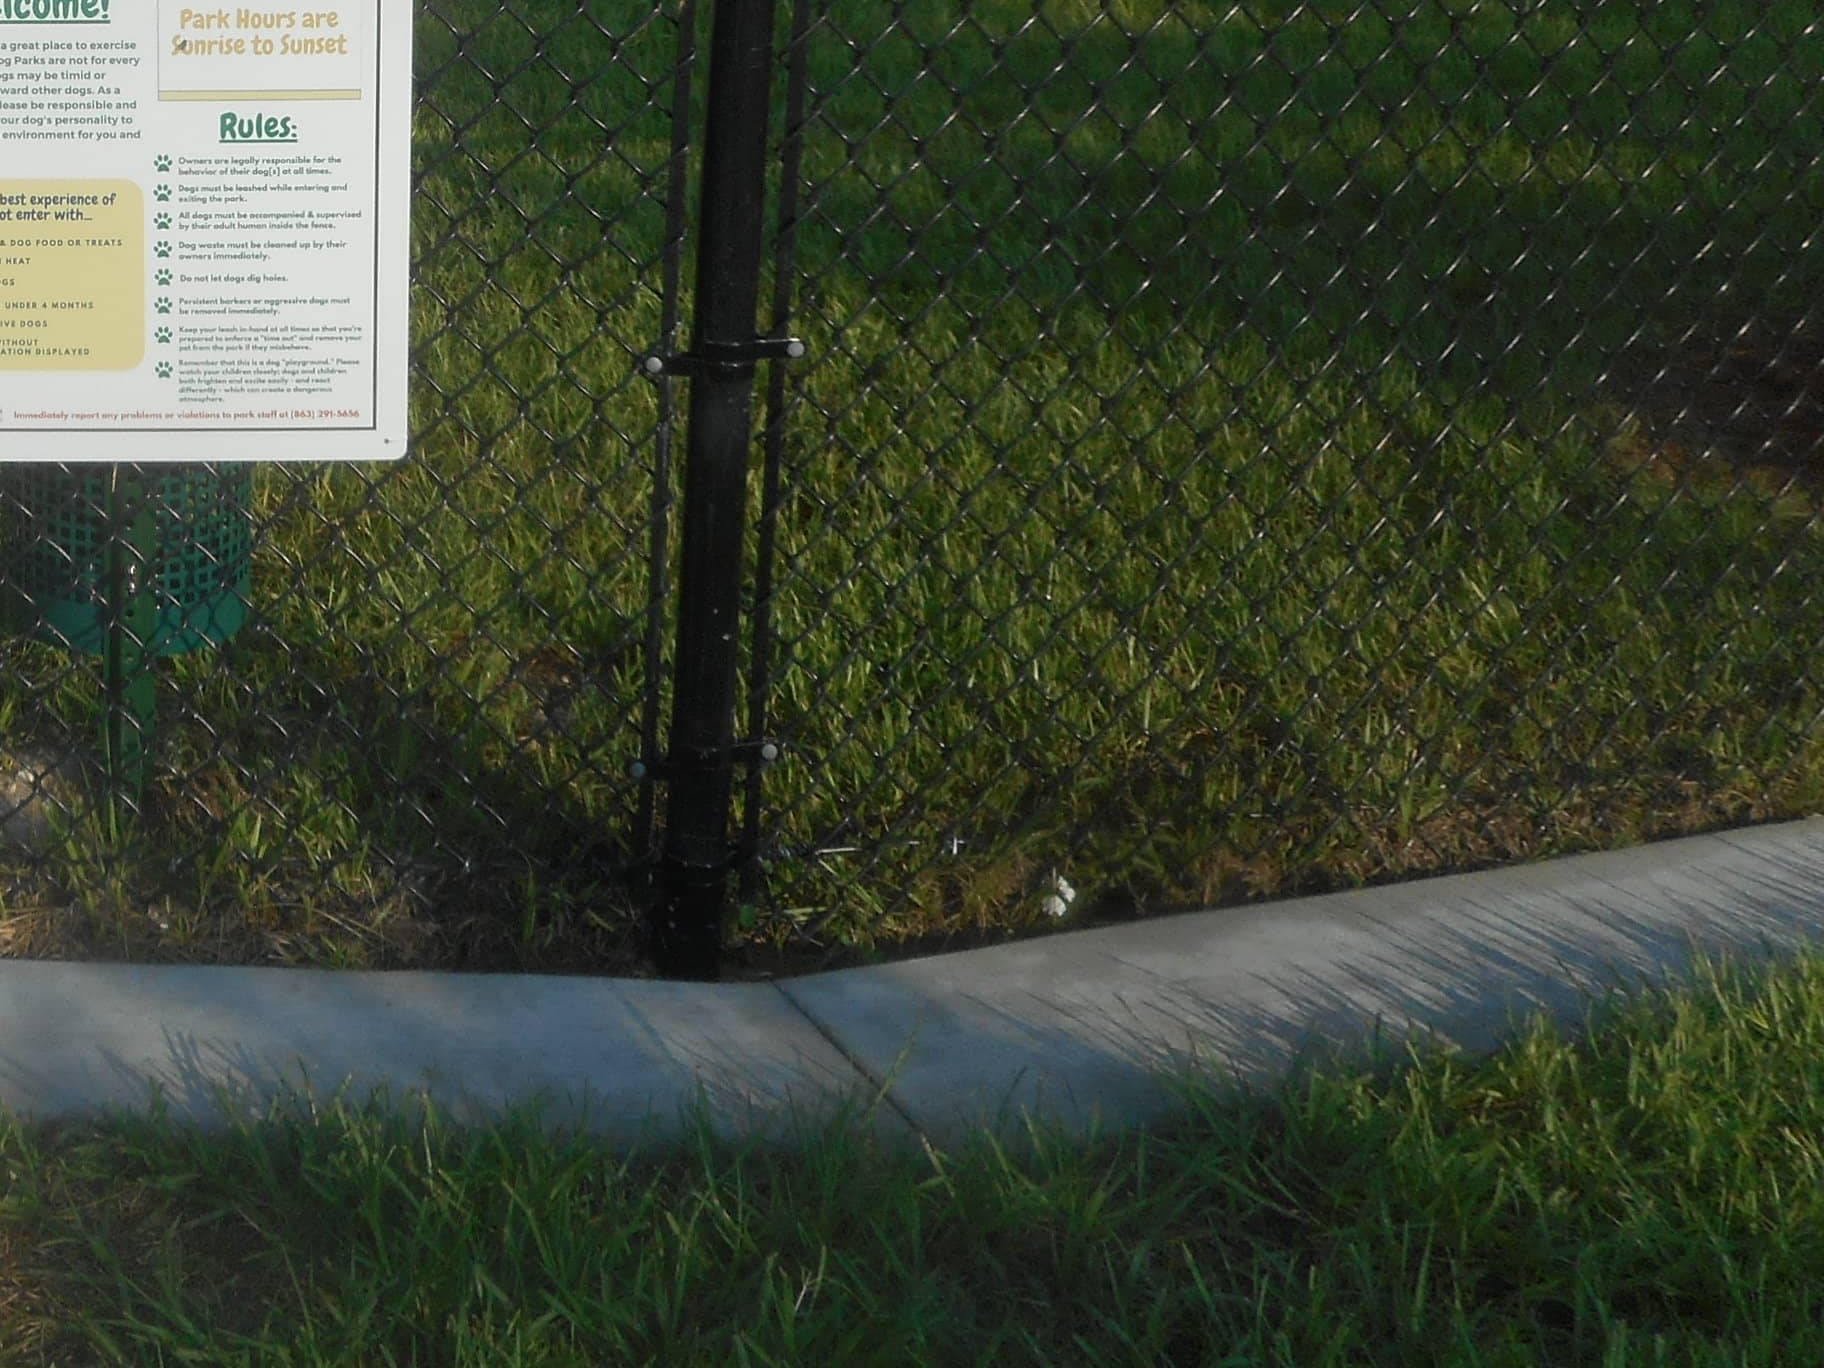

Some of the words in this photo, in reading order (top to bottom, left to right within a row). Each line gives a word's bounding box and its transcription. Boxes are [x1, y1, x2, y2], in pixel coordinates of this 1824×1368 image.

[180, 8, 229, 29] Park
[236, 8, 296, 29] Hours
[302, 11, 338, 28] are
[9, 42, 39, 52] great
[42, 40, 72, 51] place
[75, 41, 87, 49] to
[89, 39, 136, 49] exercise
[171, 34, 245, 55] Sunrise
[250, 34, 273, 55] to
[279, 33, 347, 55] Sunset
[14, 55, 45, 64] Parks
[69, 56, 87, 64] not
[90, 55, 106, 64] for
[109, 57, 140, 66] every
[17, 72, 41, 81] may
[44, 71, 57, 79] be
[60, 70, 90, 80] timid
[31, 85, 62, 94] other
[64, 85, 94, 96] dogs.
[97, 85, 111, 94] As
[30, 100, 44, 109] be
[47, 99, 112, 111] responsible
[115, 100, 136, 109] and
[22, 115, 52, 126] dog's
[55, 114, 118, 126] personality
[121, 116, 132, 124] to
[219, 112, 297, 140] Rules:
[2, 130, 74, 139] environment
[78, 129, 93, 139] for
[96, 132, 116, 141] you
[119, 130, 140, 138] and
[178, 156, 212, 164] Owners
[231, 156, 259, 166] legally
[262, 155, 310, 165] responsible
[312, 155, 325, 163] for
[327, 155, 341, 163] the
[178, 167, 216, 175] behavior
[230, 167, 250, 175] their
[178, 184, 198, 193] Dogs
[235, 183, 267, 191] leashed
[269, 183, 292, 191] while
[294, 184, 329, 192] entering
[331, 183, 347, 191] and
[0, 193, 26, 206] best
[30, 193, 98, 209] experience
[102, 192, 116, 205] of
[178, 195, 207, 204] exiting
[209, 194, 222, 202] the
[16, 208, 50, 221] enter
[178, 241, 196, 250] Dog
[263, 240, 297, 248] cleaned
[326, 239, 346, 248] their
[223, 273, 244, 283] dogs
[246, 273, 261, 283] dig
[4, 301, 36, 309] UNDER
[51, 301, 93, 309] MONTHS
[14, 410, 68, 421] Immediately
[71, 412, 99, 420] report
[120, 410, 162, 420] problems
[177, 410, 220, 418] violations
[233, 410, 254, 420] park
[257, 410, 277, 419] staff
